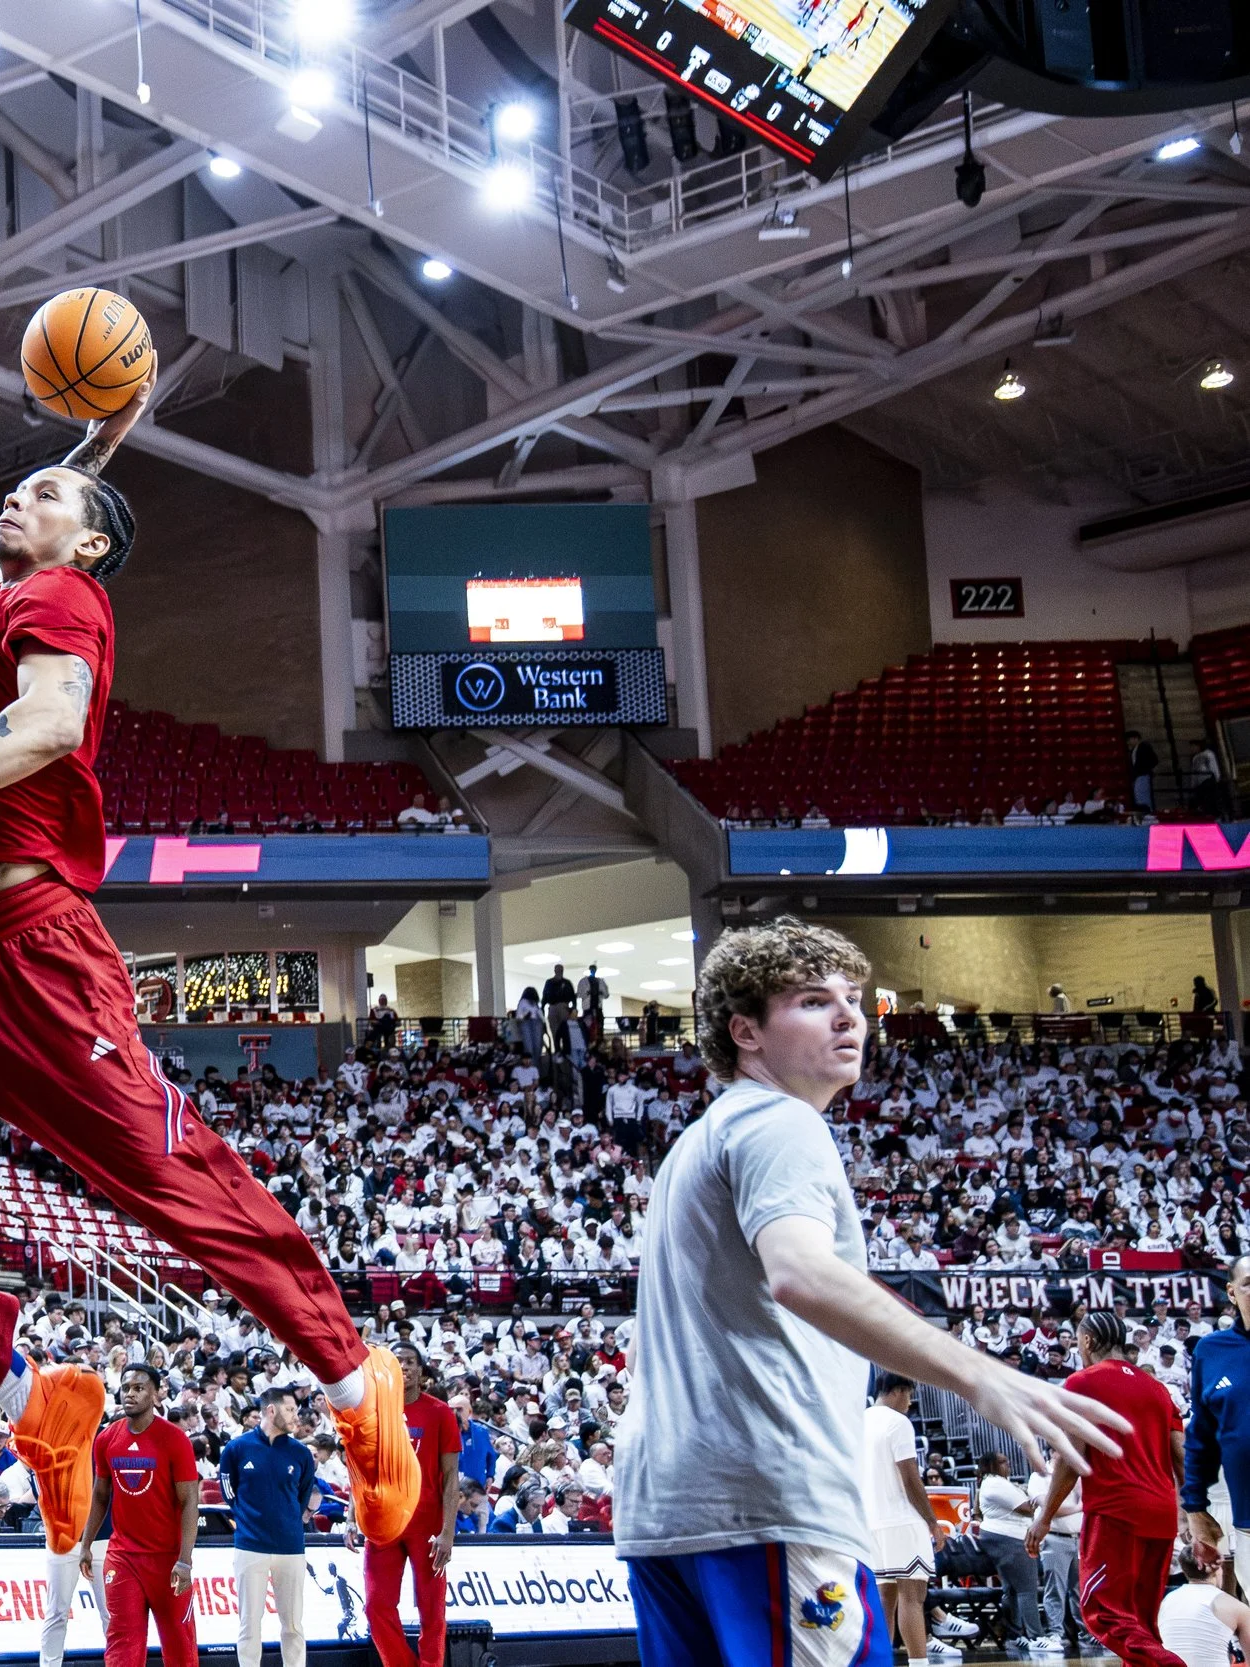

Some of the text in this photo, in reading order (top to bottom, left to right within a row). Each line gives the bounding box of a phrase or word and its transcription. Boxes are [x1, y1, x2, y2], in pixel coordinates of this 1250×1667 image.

[960, 585, 1015, 612] 222
[516, 666, 604, 687] Western
[534, 687, 588, 710] Bank
[940, 1276, 1050, 1310] WRECK
[1125, 1276, 1213, 1309] TECH
